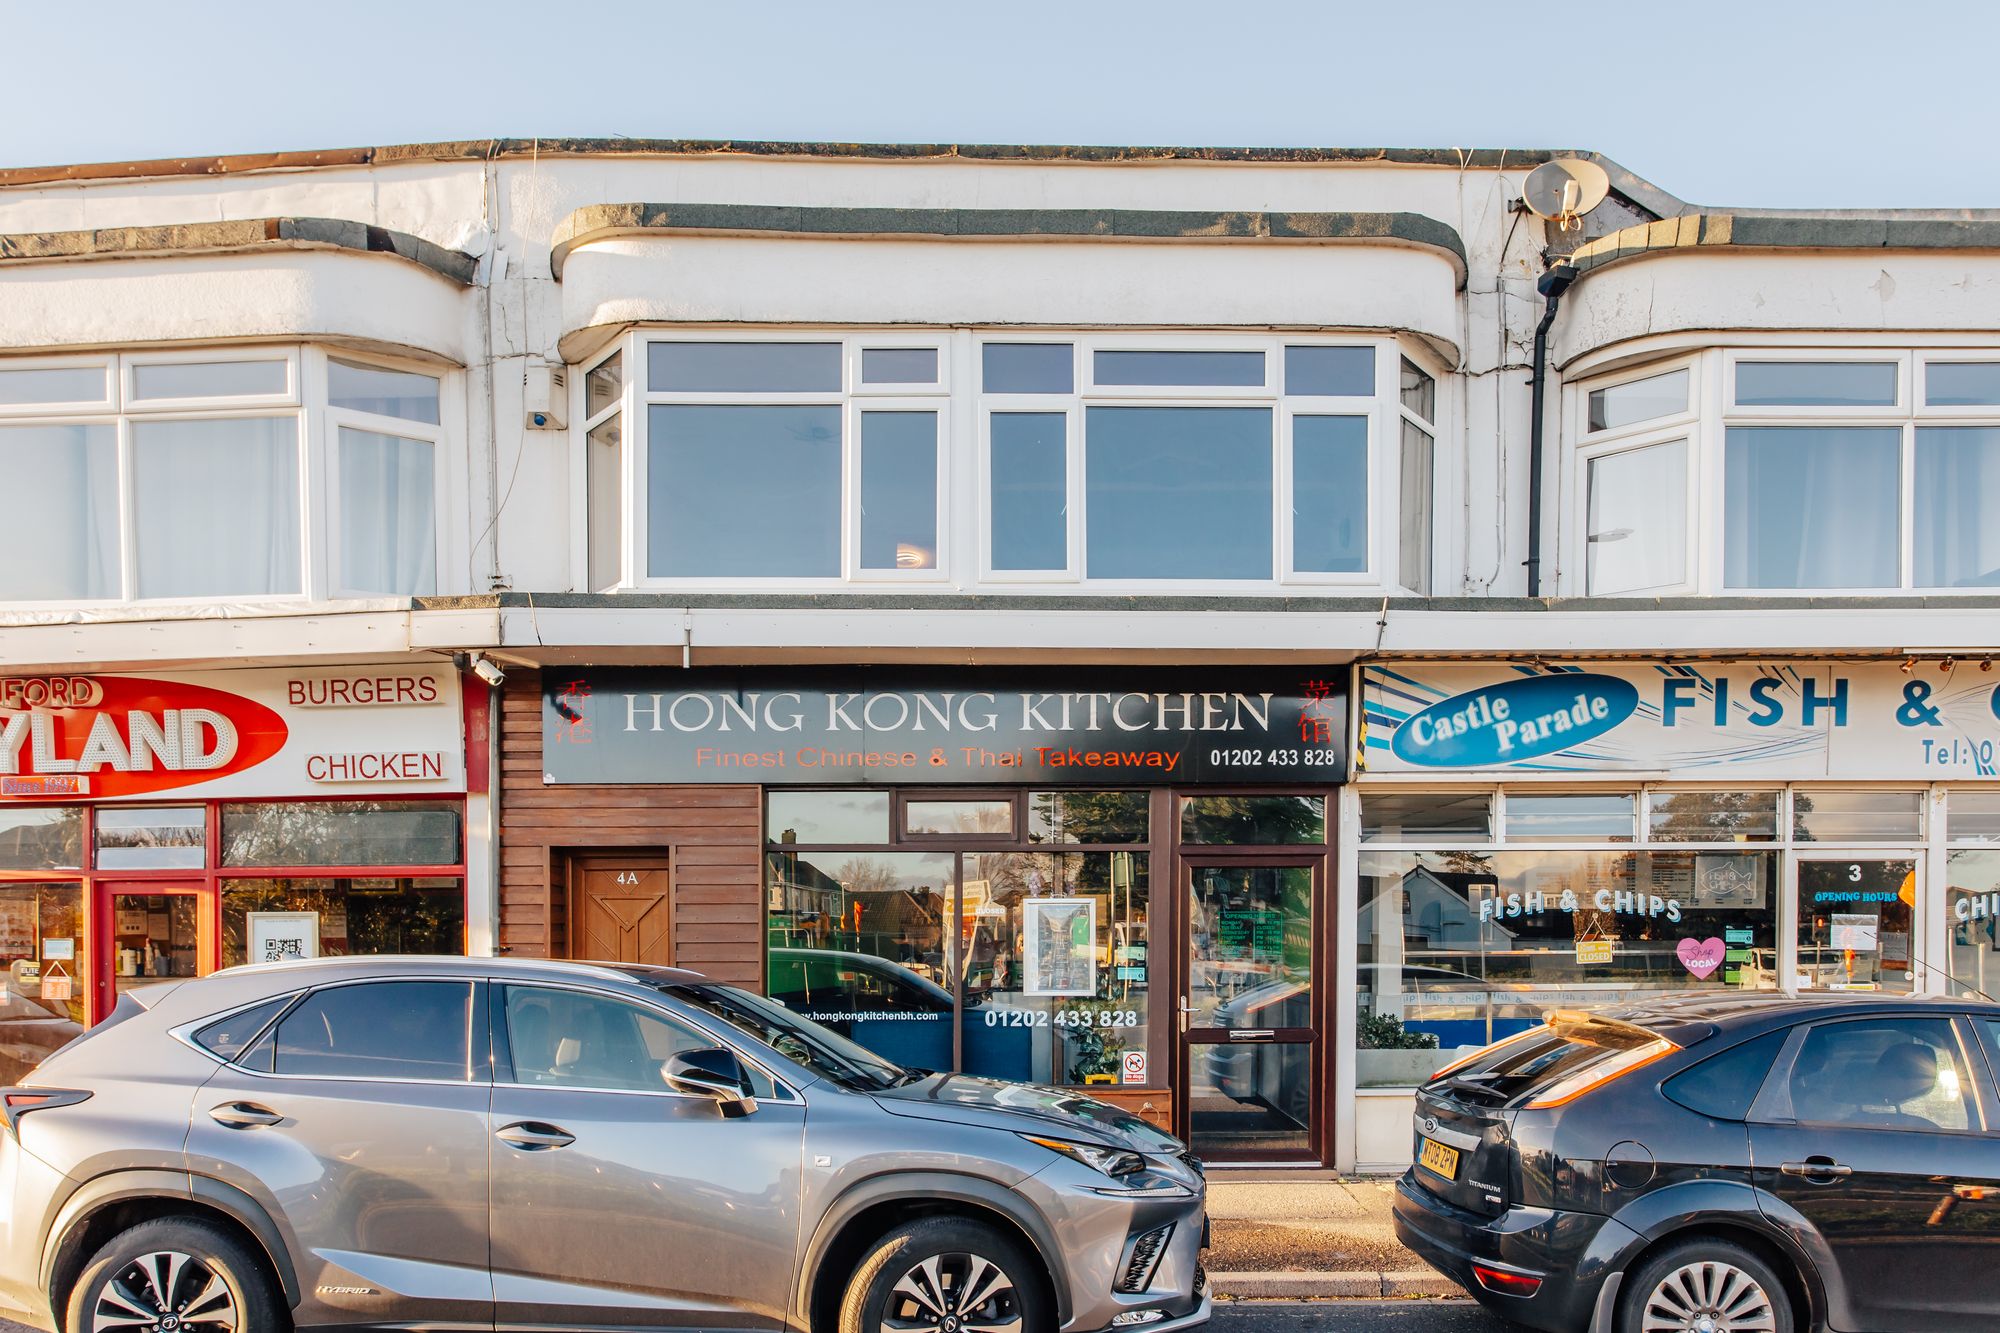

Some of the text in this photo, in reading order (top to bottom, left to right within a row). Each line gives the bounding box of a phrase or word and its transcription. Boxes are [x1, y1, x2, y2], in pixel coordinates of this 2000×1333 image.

[0, 677, 95, 707] FORD
[288, 676, 438, 706] BURGERS
[623, 691, 1274, 732] HONG KONG KITCHEN
[1662, 677, 1849, 727] FISH
[1895, 679, 1943, 727] &
[1411, 694, 1511, 747] Castle
[1491, 694, 1610, 752] Parade
[696, 746, 1180, 772] Finest Chinese & Thai Takeaway
[1210, 749, 1334, 766] 01202 433 828
[1922, 739, 2000, 764] Tel: 0
[307, 752, 442, 781] CHICKEN
[616, 871, 639, 885] 4A
[1849, 864, 1862, 882] 3
[1479, 889, 1682, 922] FISH & CHIPS
[1814, 891, 1898, 902] OPENING HOURS
[1579, 952, 1610, 961] CLOSED
[1685, 958, 1718, 968] LOCAL
[800, 1011, 938, 1022] w.hongkongkitchenbh.com
[984, 1010, 1137, 1027] 01202 433 828
[1468, 1179, 1501, 1193] TITANIUM
[315, 1286, 371, 1295] HYBRID
